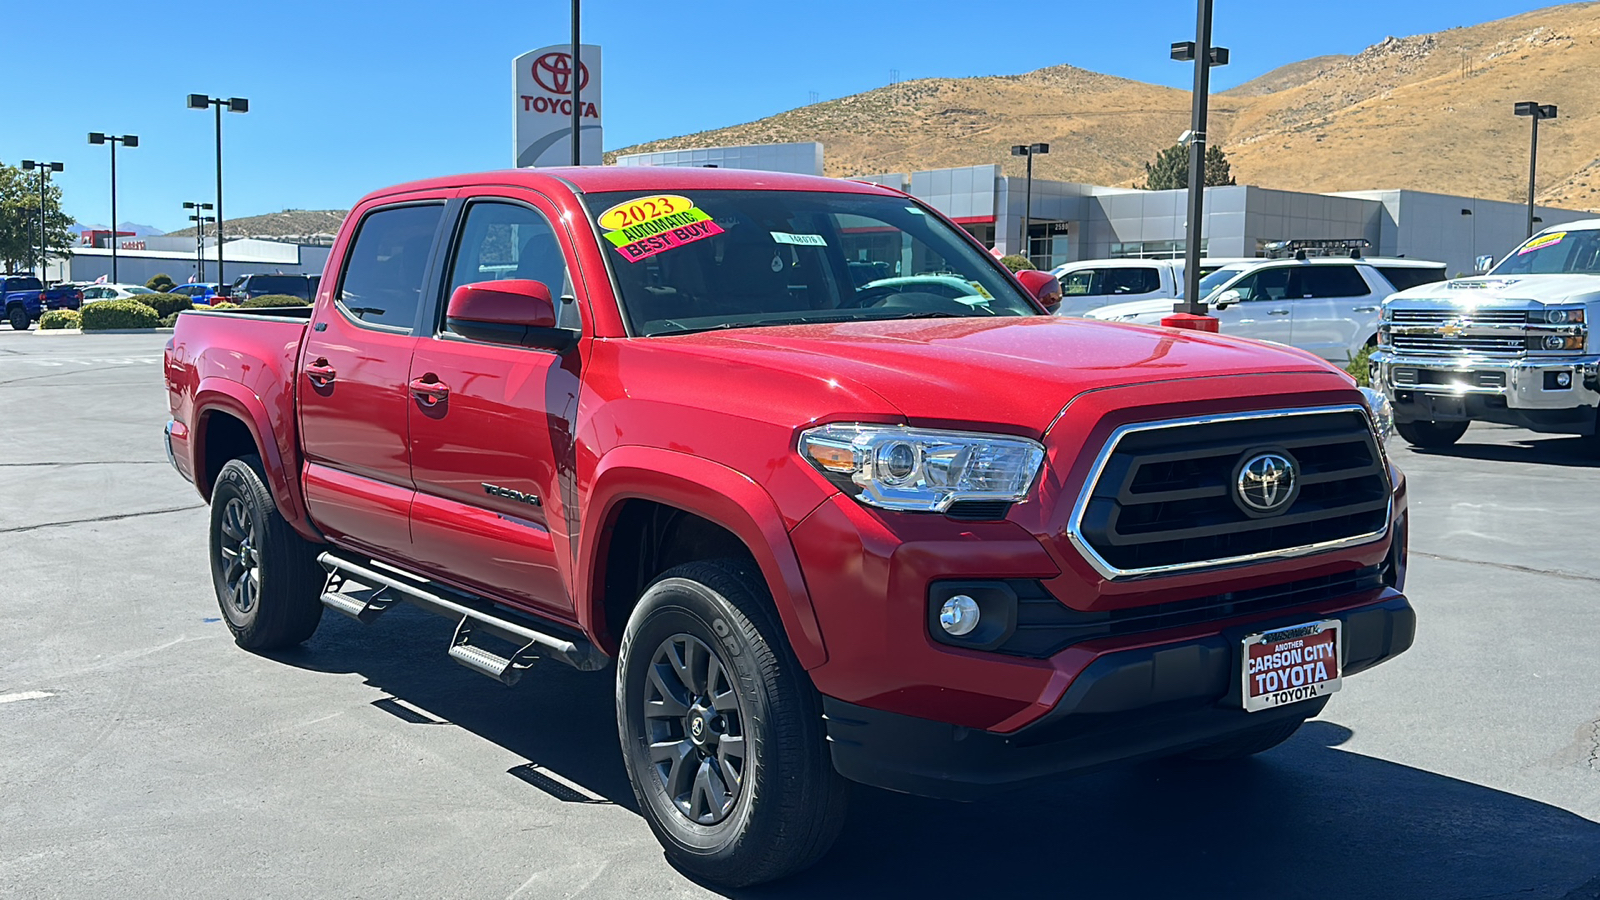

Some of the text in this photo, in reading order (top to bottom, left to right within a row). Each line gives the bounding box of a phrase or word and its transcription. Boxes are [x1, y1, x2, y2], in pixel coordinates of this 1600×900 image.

[520, 95, 598, 118] TOYOTA
[614, 197, 674, 228] 2023
[622, 211, 697, 241] AUTOMATIC
[626, 222, 709, 258] BEST BUY
[481, 482, 542, 507] TACOMA
[1248, 643, 1333, 674] CARSON CITY
[1275, 641, 1304, 652] ANOTHER
[1255, 662, 1328, 693] TOYOTA
[1272, 687, 1317, 704] TOYOTA
